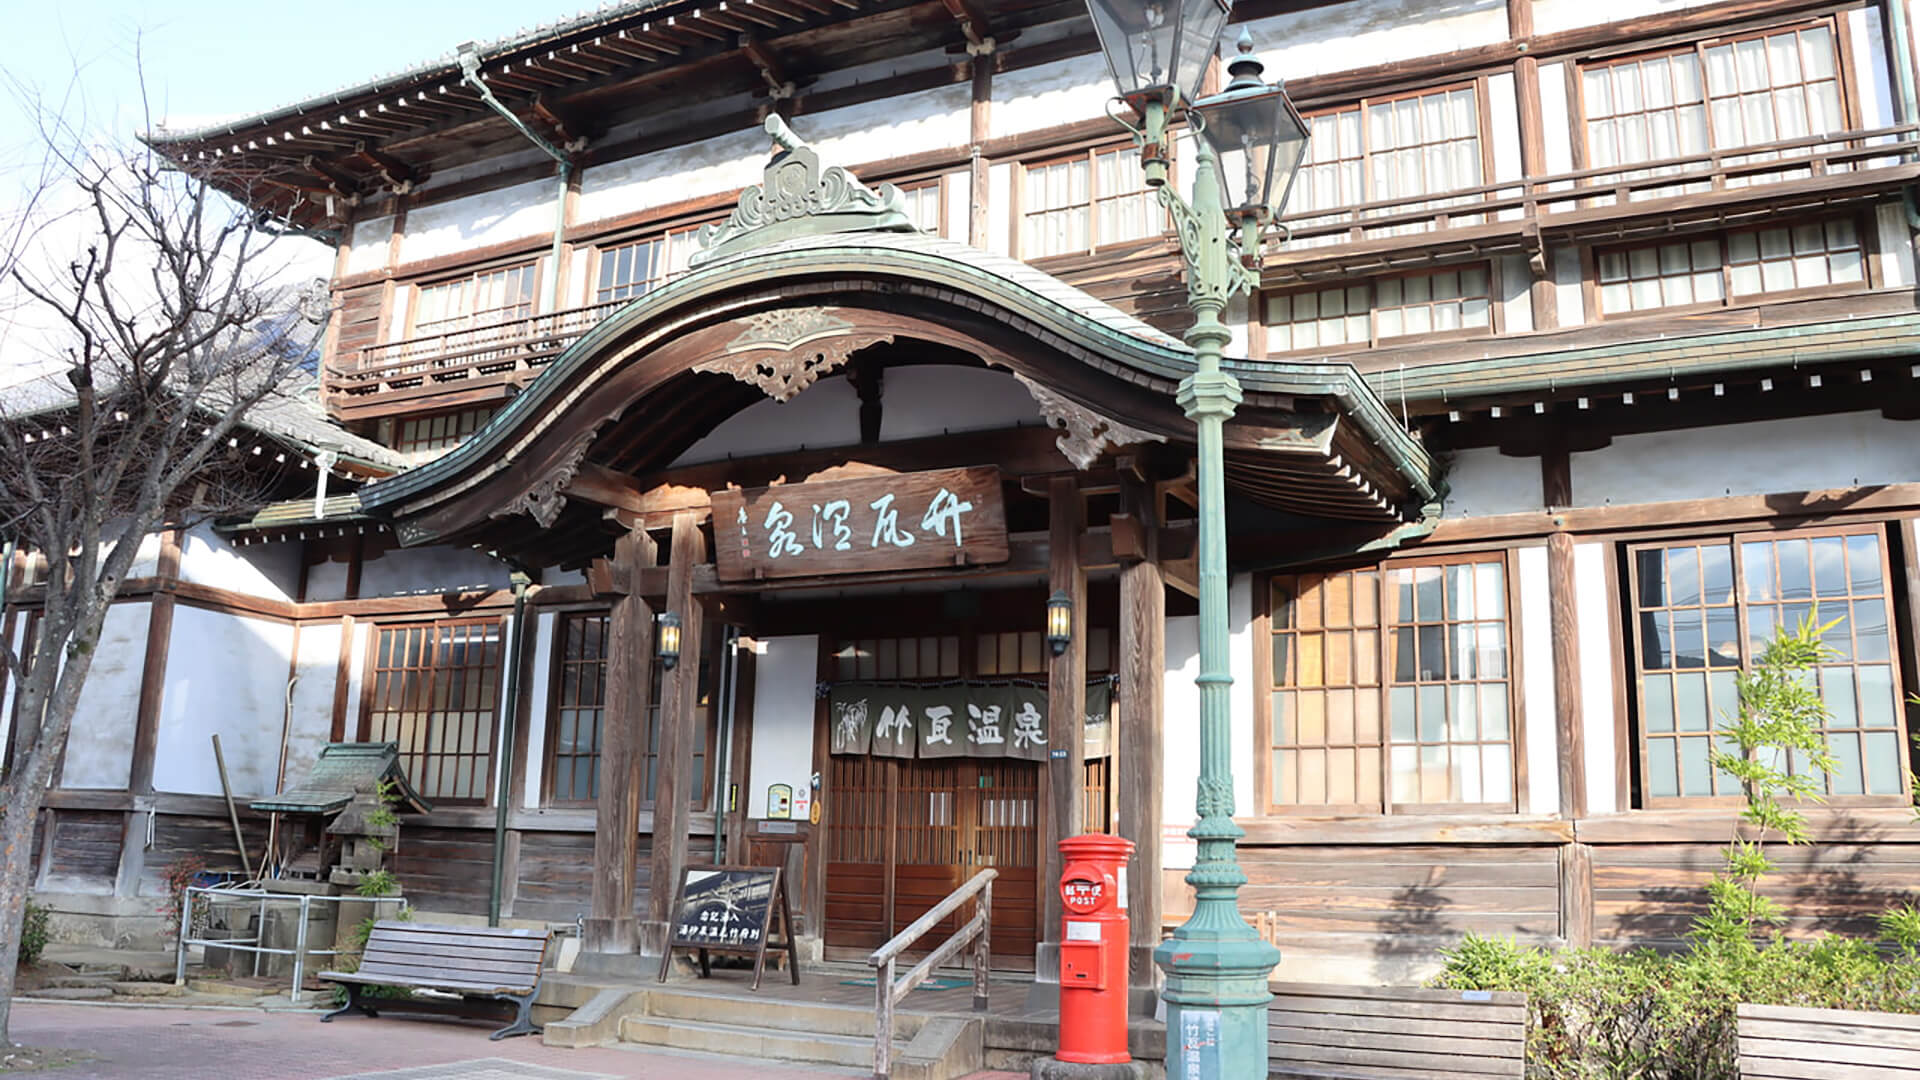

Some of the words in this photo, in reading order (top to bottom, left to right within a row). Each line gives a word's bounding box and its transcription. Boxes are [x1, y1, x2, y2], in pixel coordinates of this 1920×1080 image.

[875, 702, 1048, 749] 竹瓦温泉
[1070, 897, 1096, 905] POST
